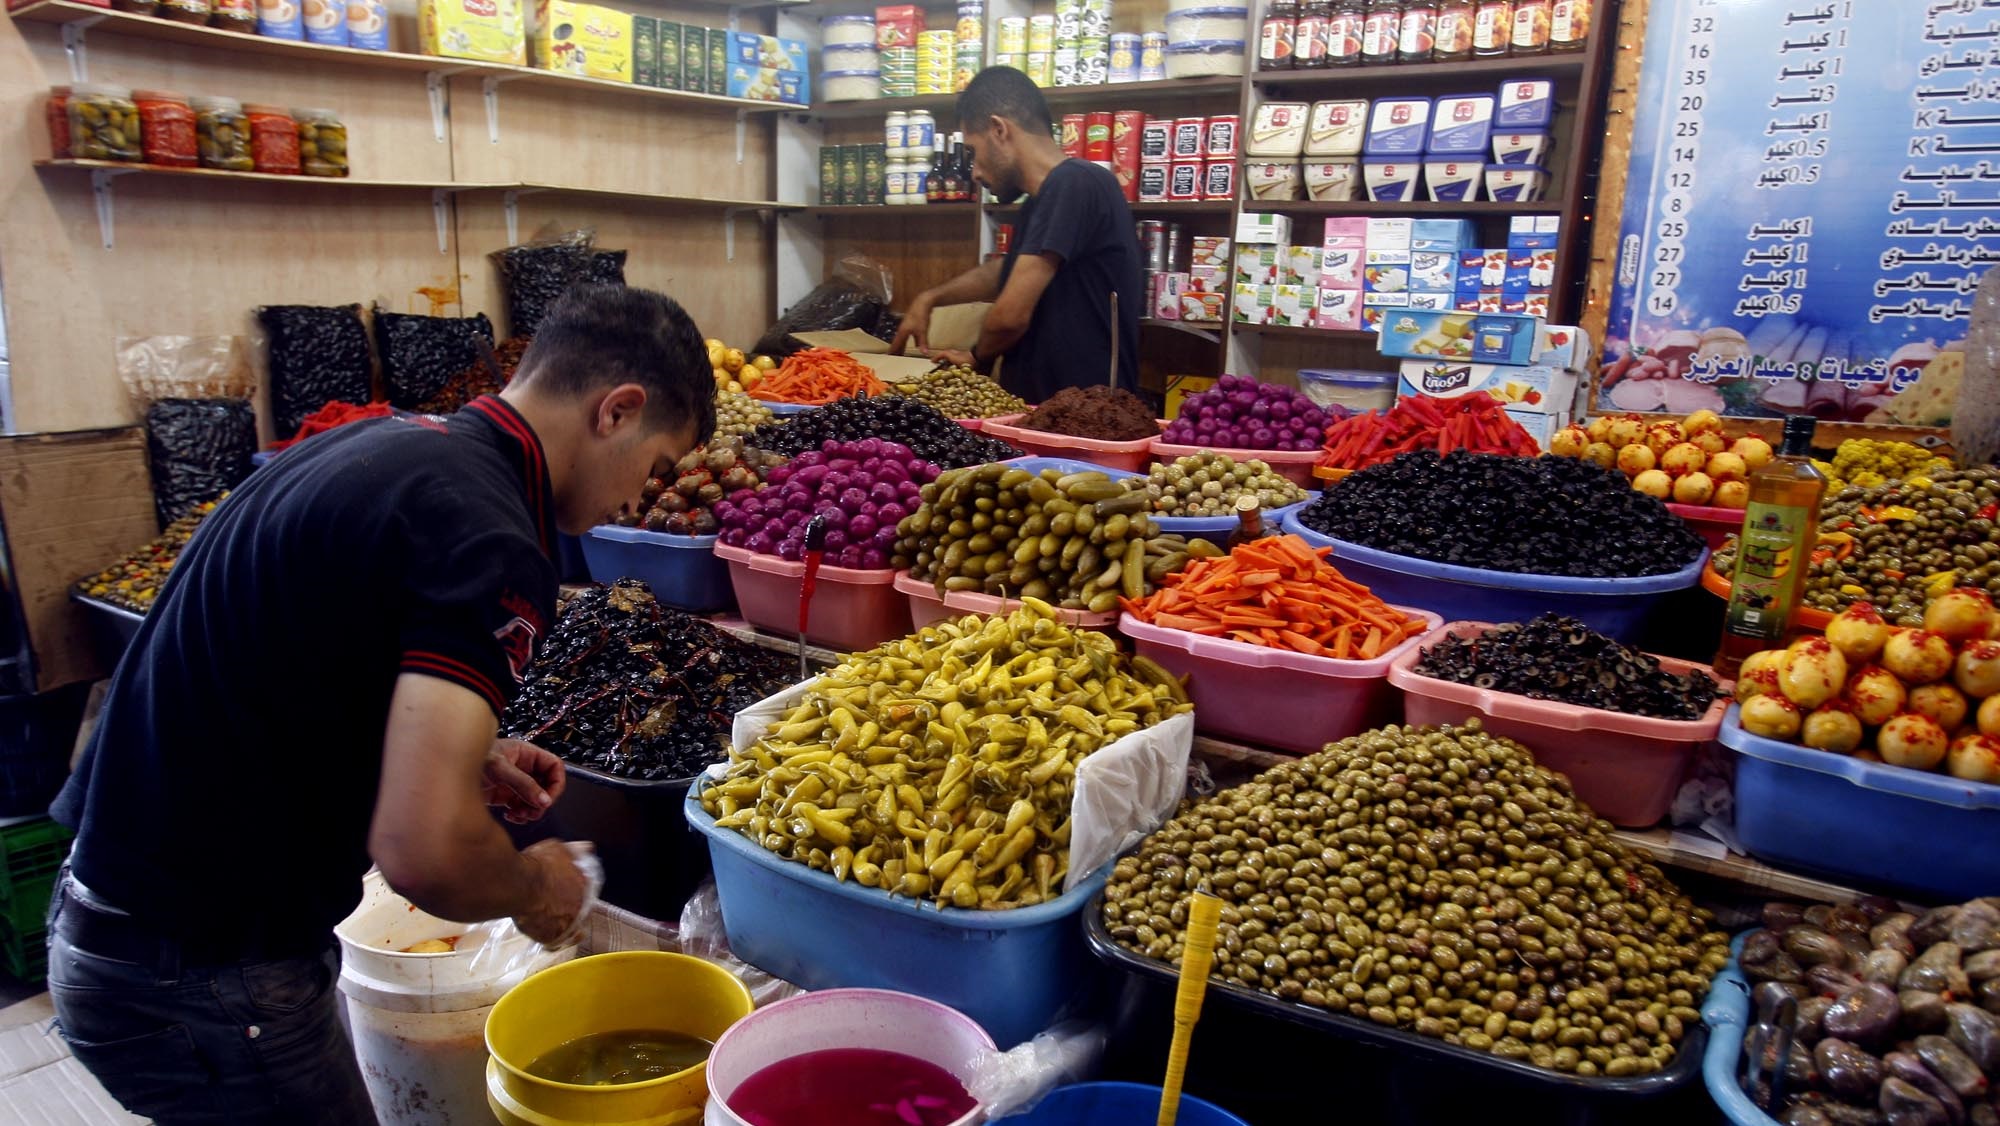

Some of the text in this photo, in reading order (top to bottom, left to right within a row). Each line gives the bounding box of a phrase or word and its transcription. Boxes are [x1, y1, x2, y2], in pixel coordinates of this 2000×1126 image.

[1691, 17, 1713, 33] 32
[1689, 44, 1710, 59] 16
[1684, 70, 1706, 85] 35
[1680, 96, 1702, 111] 20
[1916, 111, 1932, 127] K
[1676, 122, 1699, 137] 25
[1911, 139, 1927, 155] K
[1675, 148, 1695, 162] 14
[1671, 173, 1691, 187] 12
[1671, 198, 1681, 212] 8
[1662, 223, 1684, 237] 25
[1659, 248, 1680, 262] 27
[1655, 272, 1677, 286] 27
[1653, 297, 1673, 310] 14
[1684, 353, 1751, 382] العزيز
[1754, 361, 1798, 384] عبد
[1818, 358, 1888, 388] تحيات
[1893, 366, 1920, 391] مع
